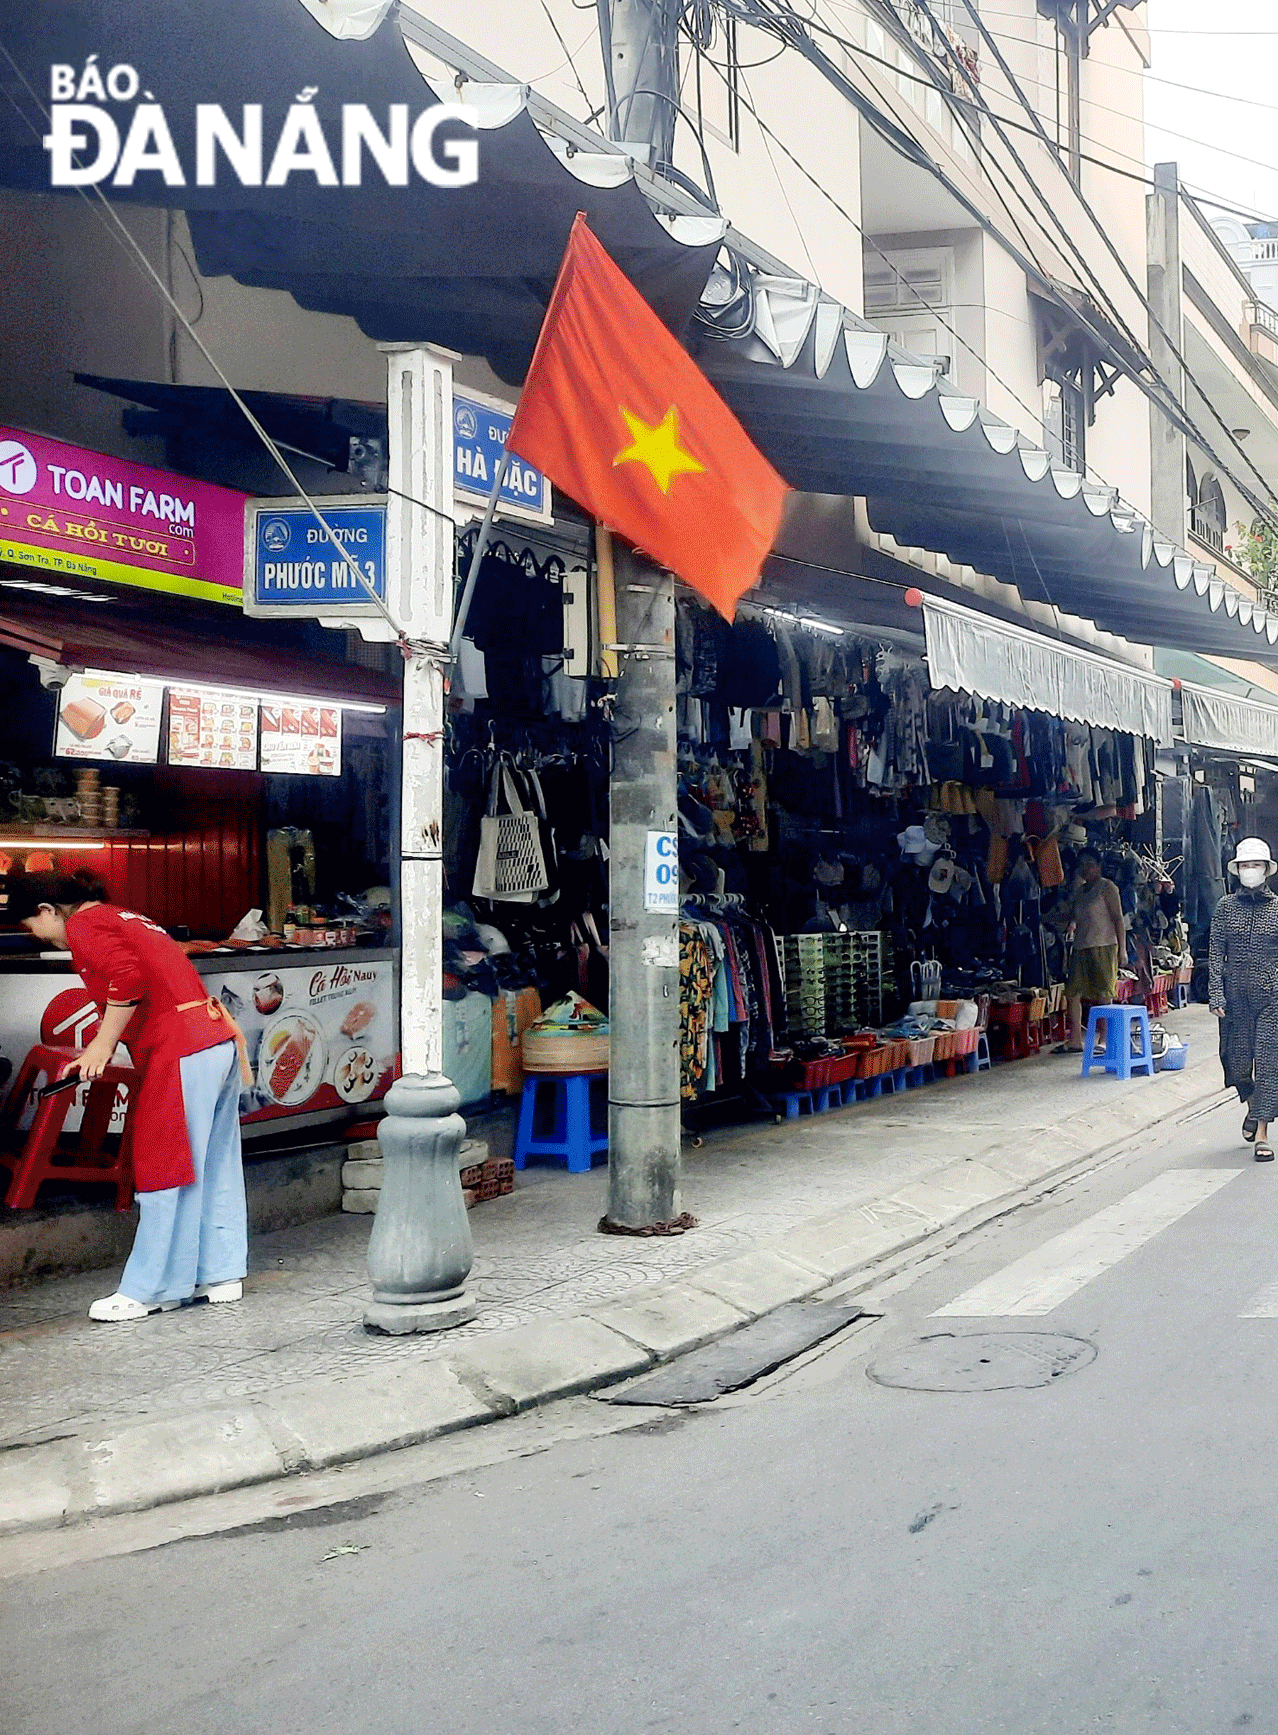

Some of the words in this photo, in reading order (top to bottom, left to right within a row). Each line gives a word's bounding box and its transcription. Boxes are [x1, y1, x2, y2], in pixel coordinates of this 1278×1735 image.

[456, 445, 488, 482] HÀ
[47, 464, 123, 510] TOAN
[129, 485, 195, 527] FARM
[27, 514, 61, 533] CÁ
[65, 519, 108, 543] HỒI
[112, 532, 168, 556] TƯƠI
[169, 523, 194, 539] com
[306, 526, 368, 544] ĐƯỜNG
[264, 555, 326, 590] PHƯỚC
[364, 561, 376, 590] 3
[309, 970, 327, 997] Cá
[330, 965, 353, 989] Hồi
